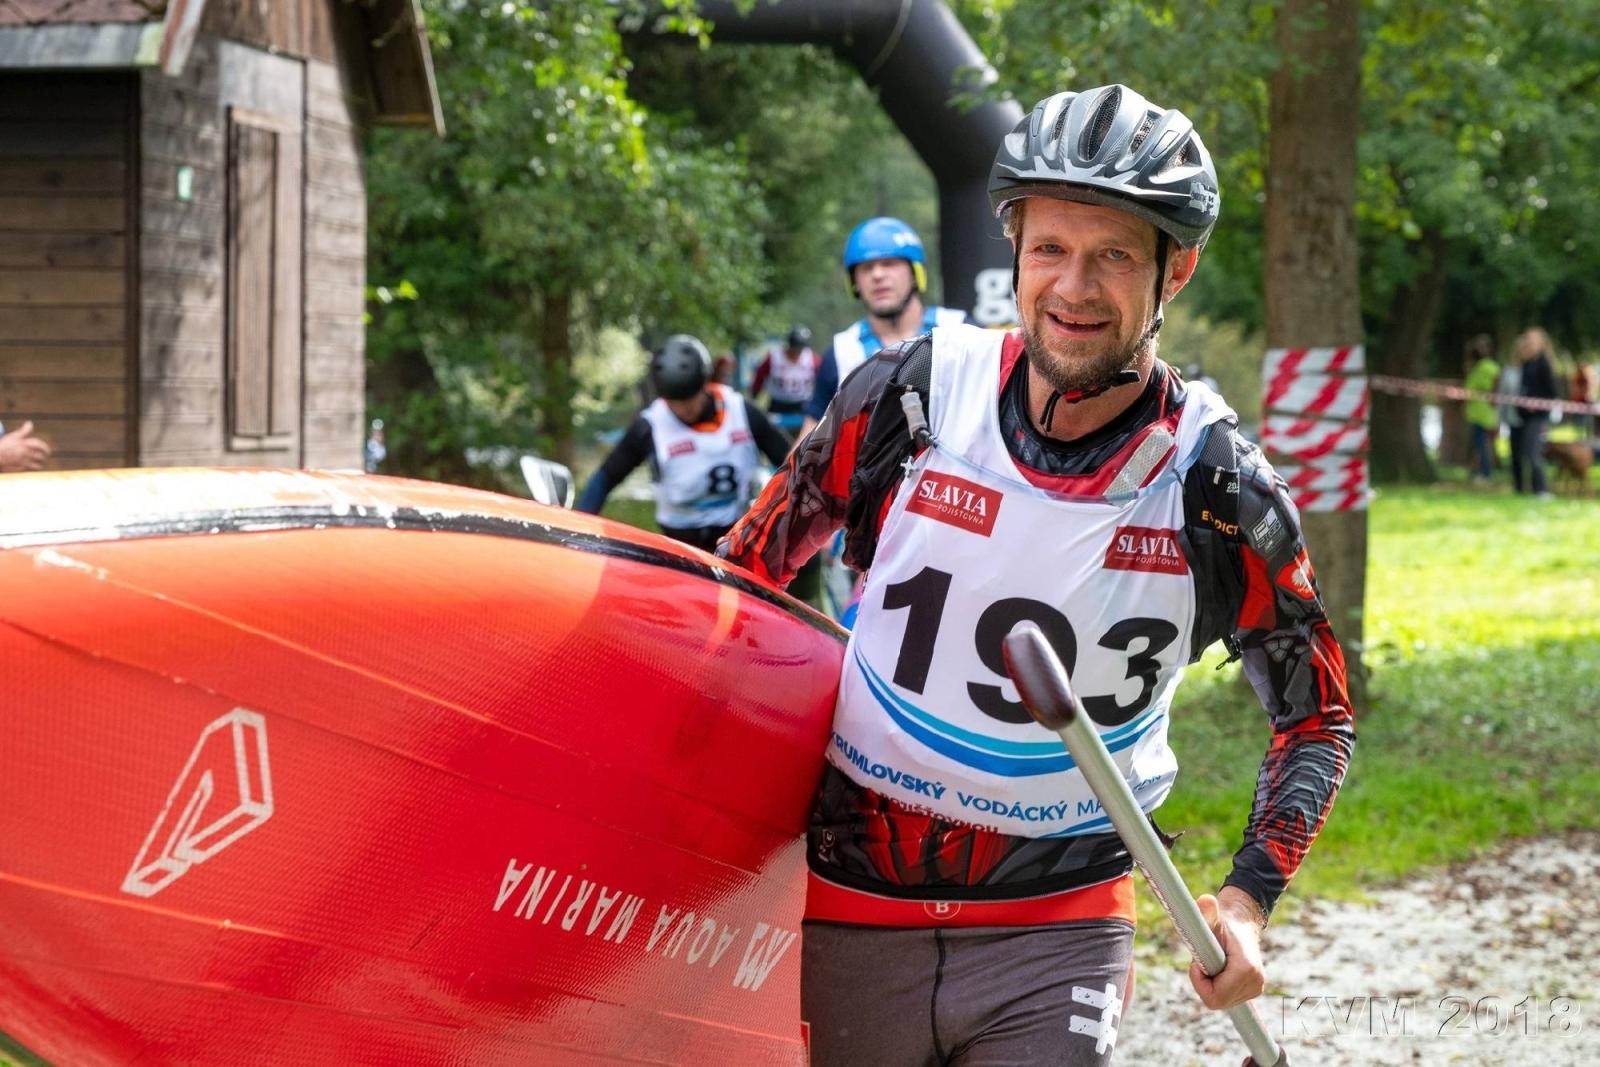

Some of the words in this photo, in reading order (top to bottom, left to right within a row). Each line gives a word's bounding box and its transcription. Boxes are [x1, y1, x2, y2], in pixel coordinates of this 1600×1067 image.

[709, 465, 737, 494] 8
[919, 480, 987, 517] SLAVIA
[1201, 510, 1239, 536] EDICT
[1116, 534, 1179, 558] SLAVIA
[882, 566, 1179, 727] 193
[956, 791, 1068, 822] VODÁCKÝ
[492, 858, 646, 945] MARINA
[646, 903, 741, 968] AQUA
